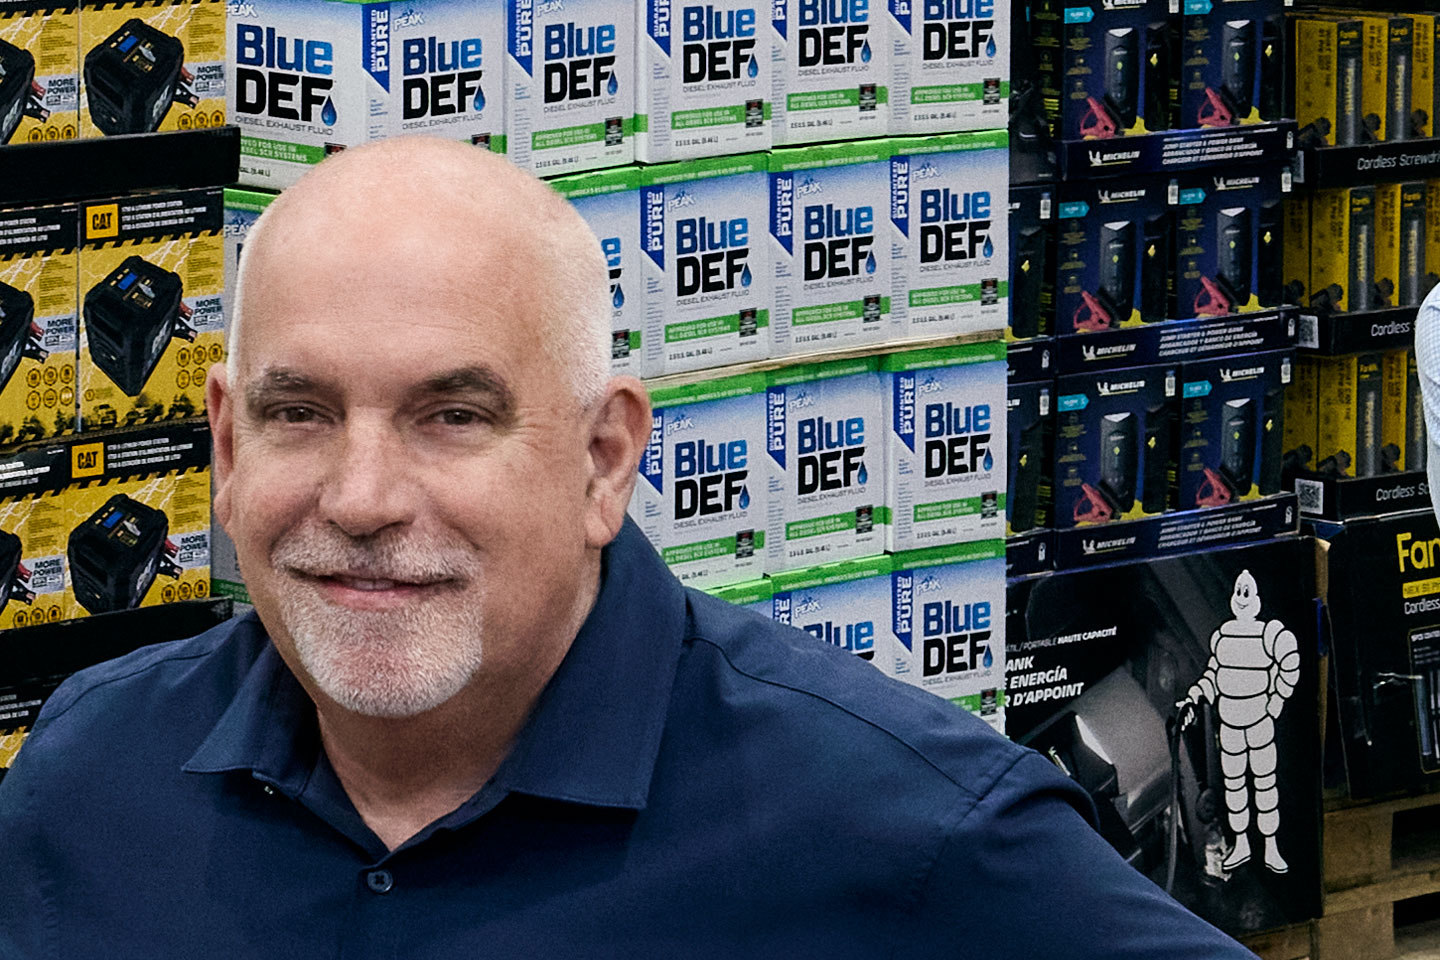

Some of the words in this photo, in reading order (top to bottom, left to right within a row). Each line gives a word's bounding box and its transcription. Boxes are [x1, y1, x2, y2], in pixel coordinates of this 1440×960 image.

[394, 13, 424, 31] PEAK
[683, 6, 755, 42] Blue
[799, 0, 868, 26] Blue
[237, 24, 333, 75] Blue
[376, 9, 388, 72] PURE
[404, 38, 482, 74] Blue
[545, 24, 615, 60] Blue
[799, 25, 868, 67] DEF
[924, 20, 993, 60] DEF
[684, 39, 755, 83] DEF
[236, 68, 333, 121] DEF
[403, 71, 483, 119] DEF
[545, 56, 615, 103] DEF
[235, 116, 264, 126] DIESEL
[266, 120, 306, 132] EXHAUST
[308, 126, 334, 135] FLUID
[1103, 151, 1140, 161] MICHELIN
[1357, 156, 1396, 170] Cordless
[1399, 152, 1440, 166] Screwdri
[668, 194, 695, 211] PEAK
[782, 178, 792, 236] PURE
[796, 182, 822, 198] PEAK
[921, 190, 991, 222] Blue
[1110, 190, 1146, 198] MICHELIN
[92, 212, 113, 230] CAT
[653, 192, 663, 251] PURE
[676, 218, 748, 254] Blue
[804, 205, 873, 240] Blue
[805, 236, 873, 281] DEF
[921, 221, 990, 263] DEF
[677, 248, 751, 296] DEF
[1371, 321, 1410, 337] Cordless
[1097, 345, 1136, 355] MICHELIN
[1110, 380, 1145, 390] MICHELIN
[774, 393, 784, 450] PURE
[904, 377, 914, 434] PURE
[926, 404, 990, 437] Blue
[667, 418, 694, 435] PEAK
[798, 417, 864, 453] Blue
[77, 451, 98, 469] CAT
[675, 440, 747, 477] Blue
[798, 447, 866, 495] DEF
[926, 434, 990, 478] DEF
[675, 470, 747, 519] DEF
[1376, 485, 1414, 501] Cordless
[1097, 537, 1136, 549] MICHELIN
[794, 601, 822, 618] PEAK
[901, 577, 912, 633] PURE
[924, 602, 991, 636] Blue
[1057, 634, 1082, 644] HAUTE
[1082, 626, 1117, 640] CAPACITÉ
[923, 631, 991, 676] DEF
[1006, 655, 1034, 672] ANK
[1010, 665, 1068, 689] ENERGÍA
[1013, 682, 1084, 706] D'APPOINT
